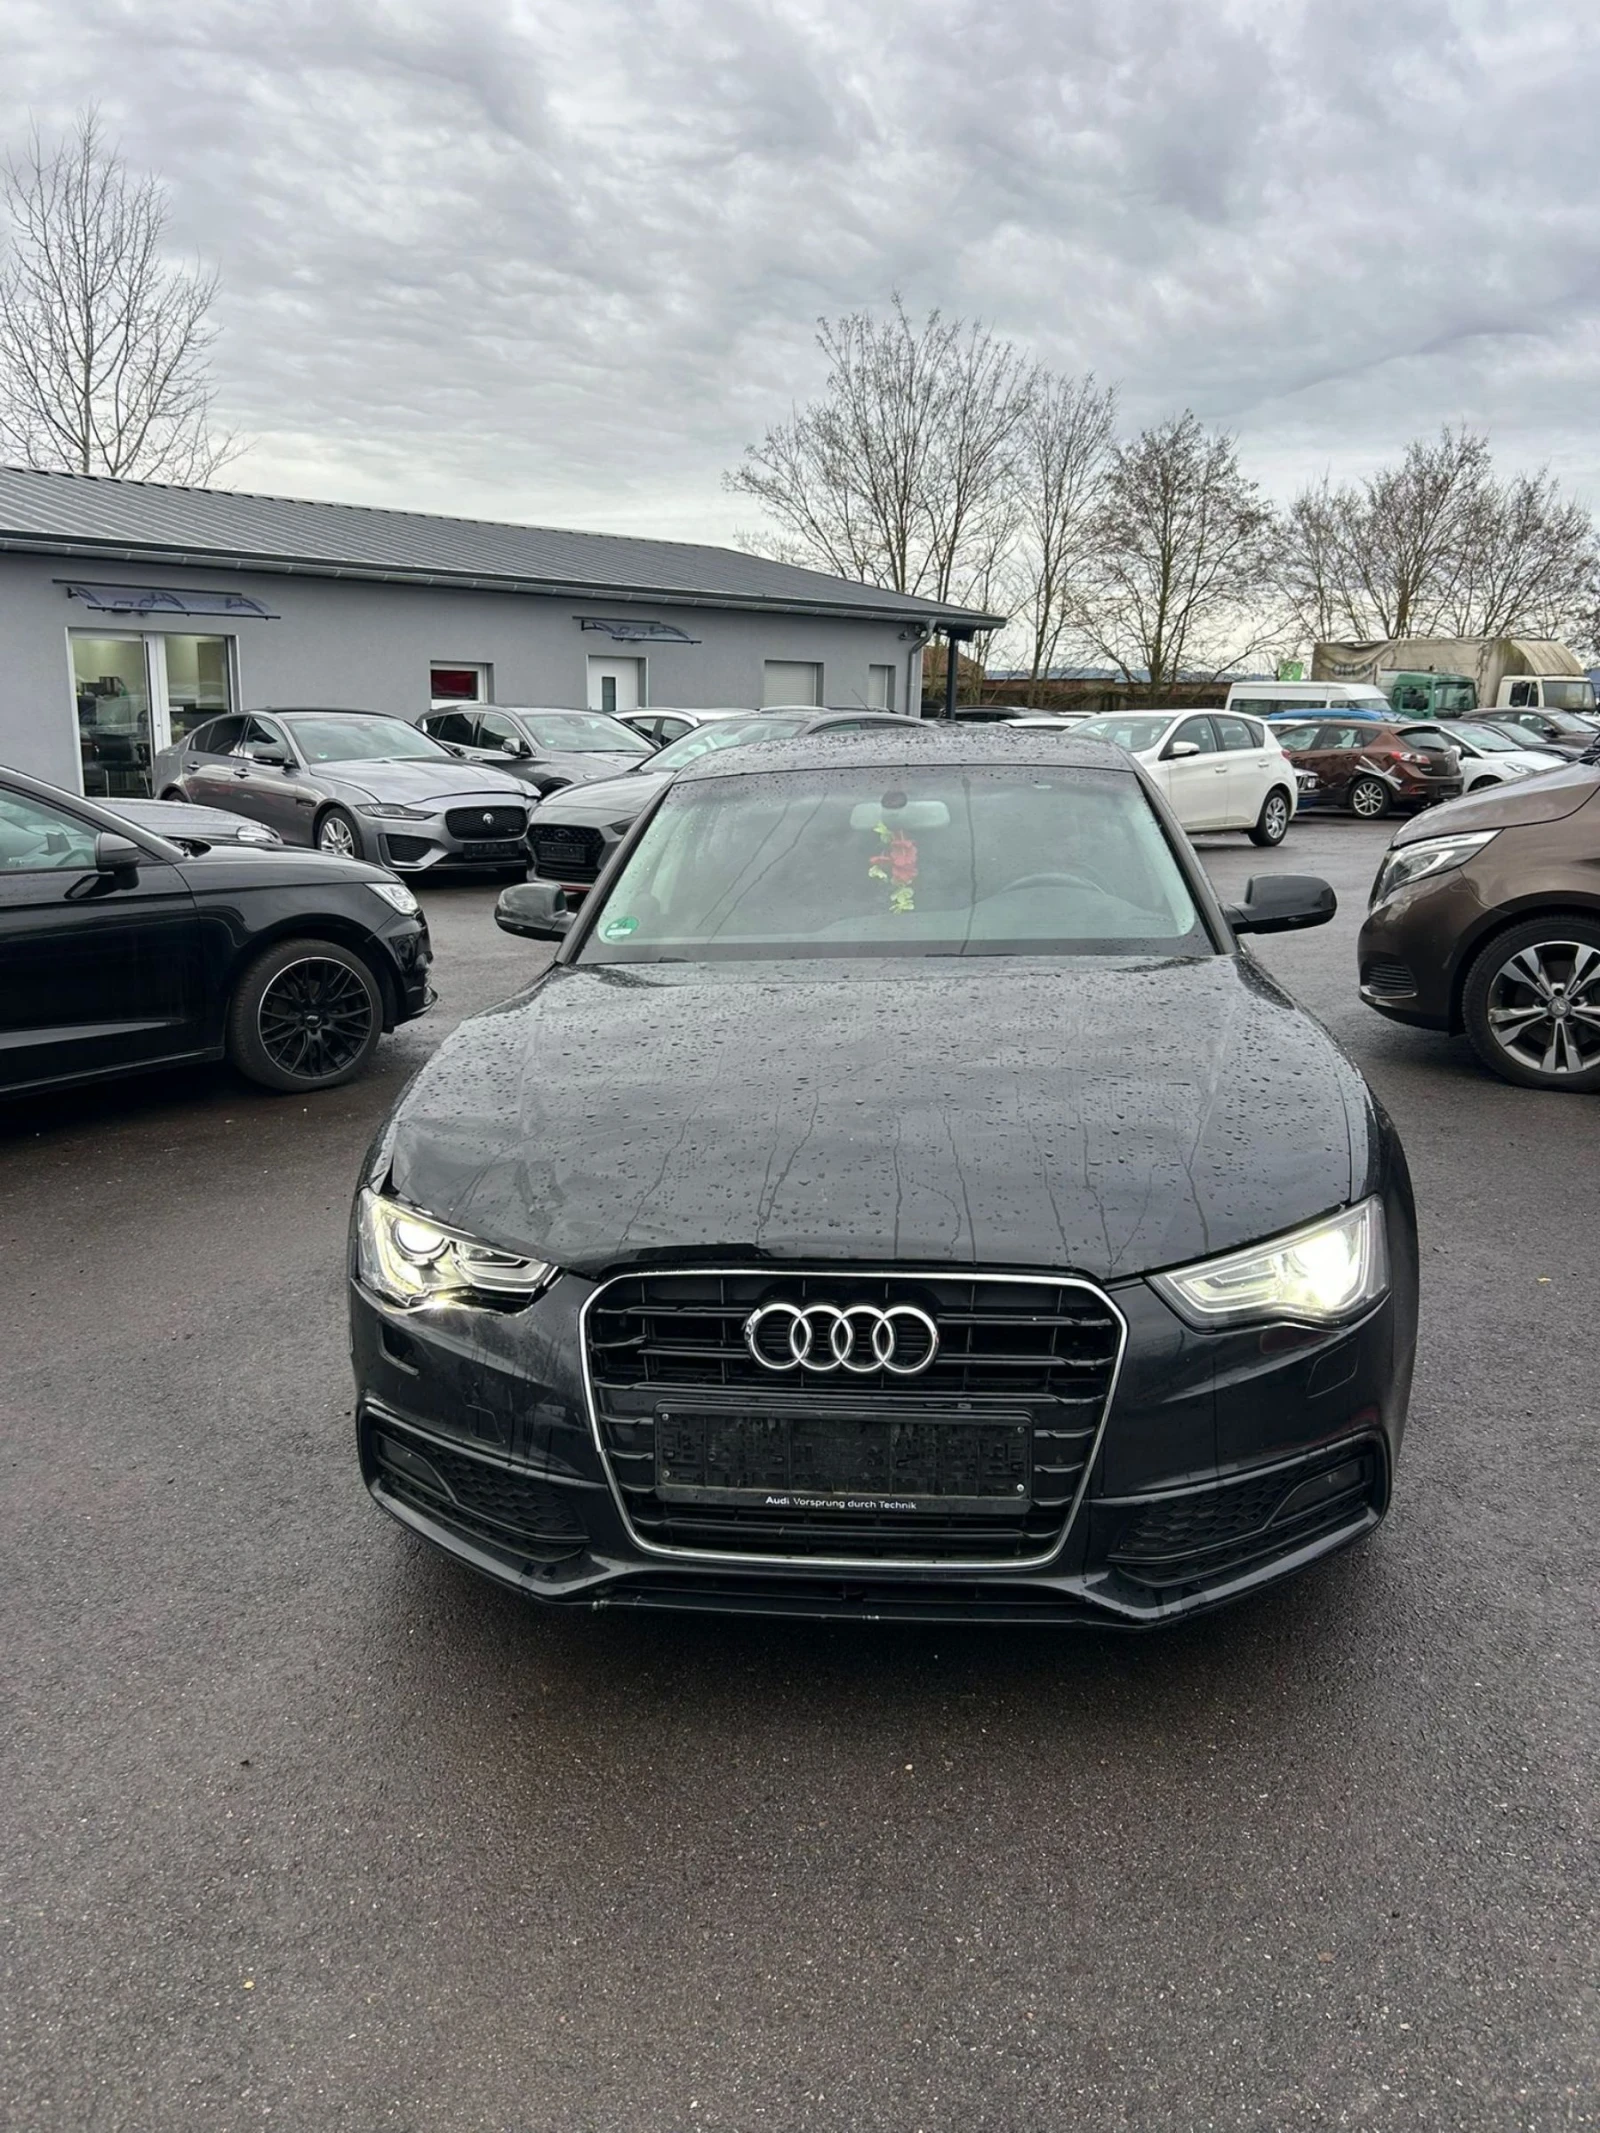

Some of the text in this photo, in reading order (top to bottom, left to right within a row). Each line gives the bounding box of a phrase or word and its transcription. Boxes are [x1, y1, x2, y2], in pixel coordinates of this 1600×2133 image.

[765, 1496, 917, 1510] Audi Vorsprung durch Technik
